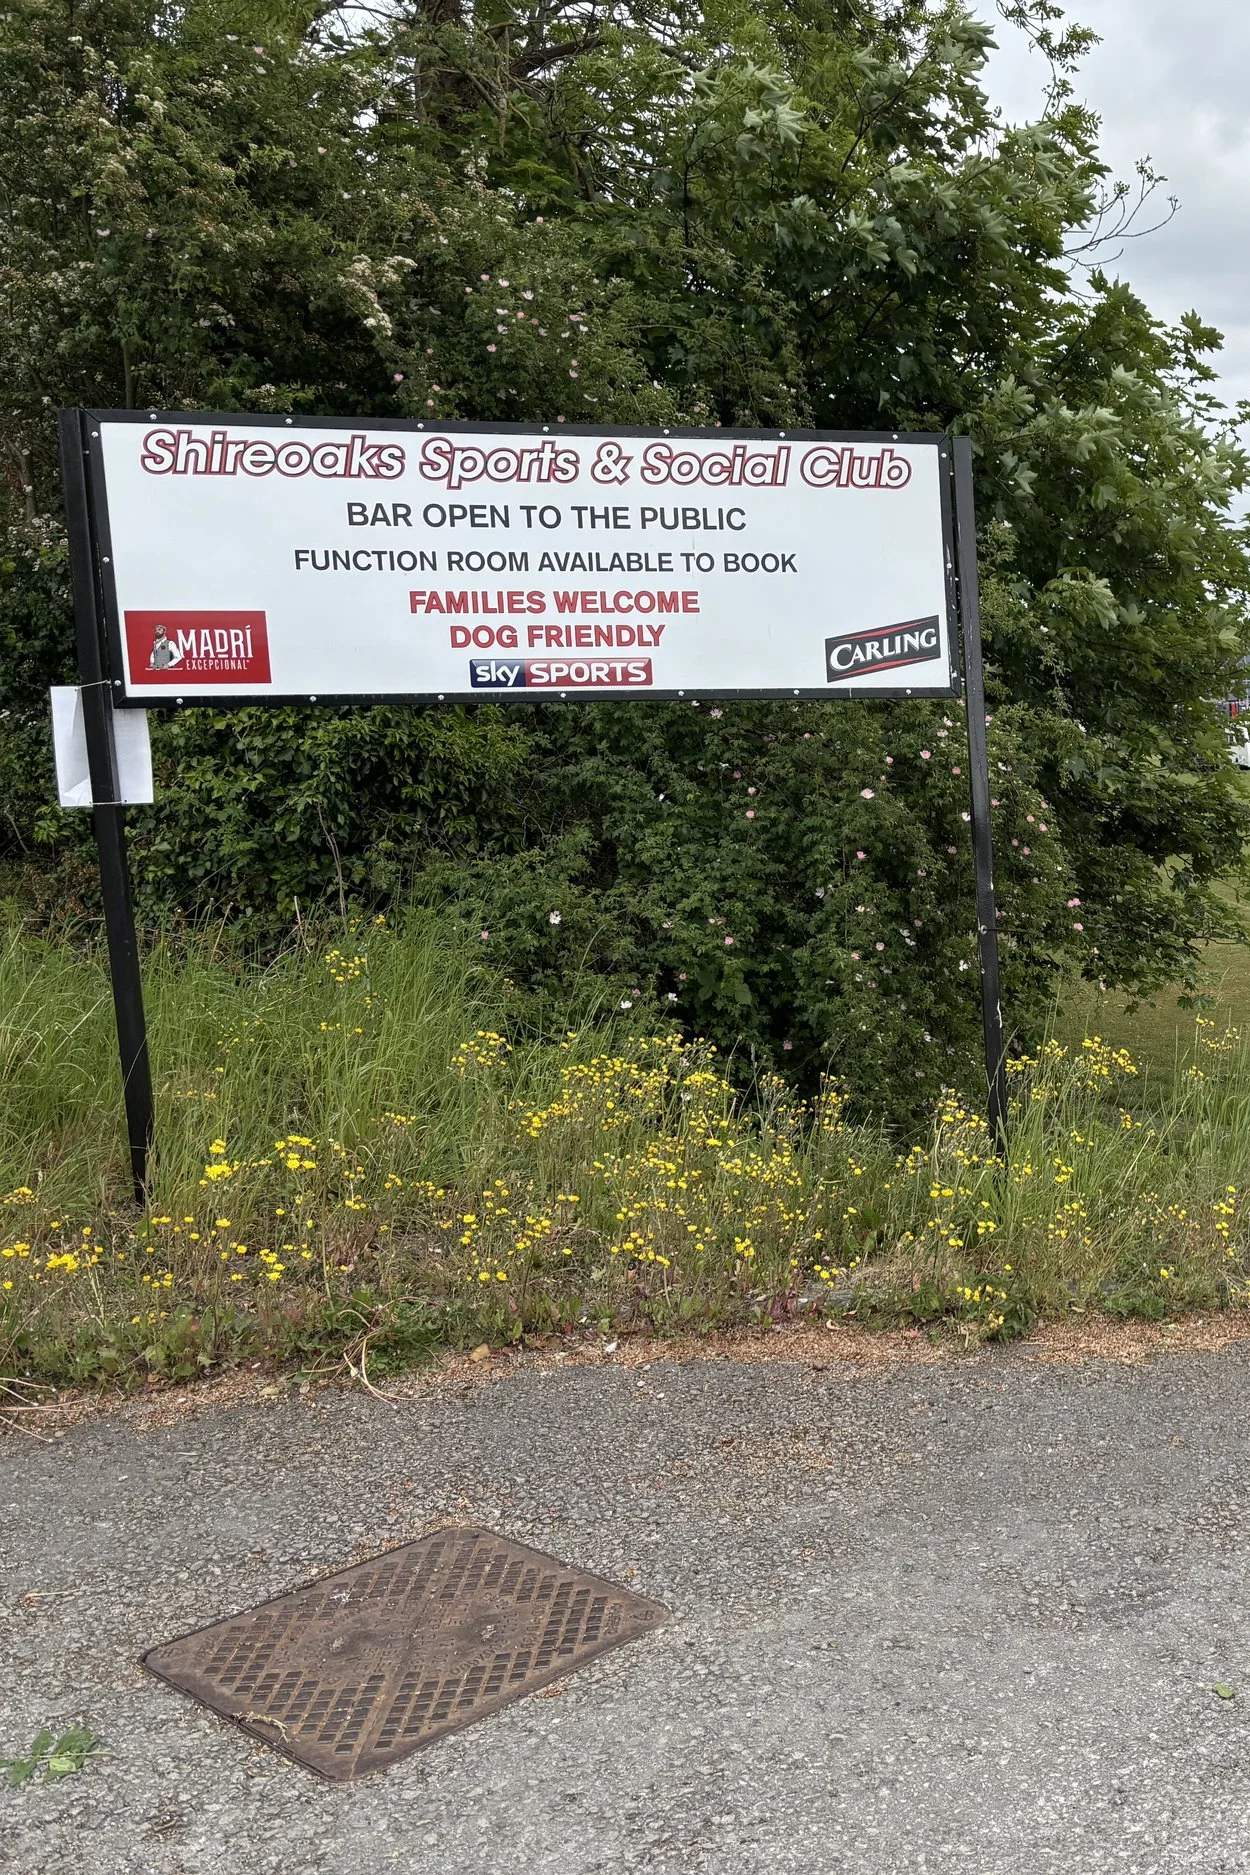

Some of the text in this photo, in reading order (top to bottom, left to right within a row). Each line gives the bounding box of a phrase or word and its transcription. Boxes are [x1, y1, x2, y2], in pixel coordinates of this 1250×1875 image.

[140, 428, 912, 490] Shireoaks Sports & Social Club
[347, 502, 747, 531] BAR OPEN TO THE PUBLIC
[294, 549, 798, 573] FUNCTION ROOM AVAILABLE TO BOOK
[409, 590, 700, 614] FAMILIES WELCOME
[176, 625, 253, 659] MADRÍ
[450, 624, 666, 649] DOG FRIENDLY
[829, 627, 938, 673] CARLING
[475, 661, 647, 686] sky SPORTS
